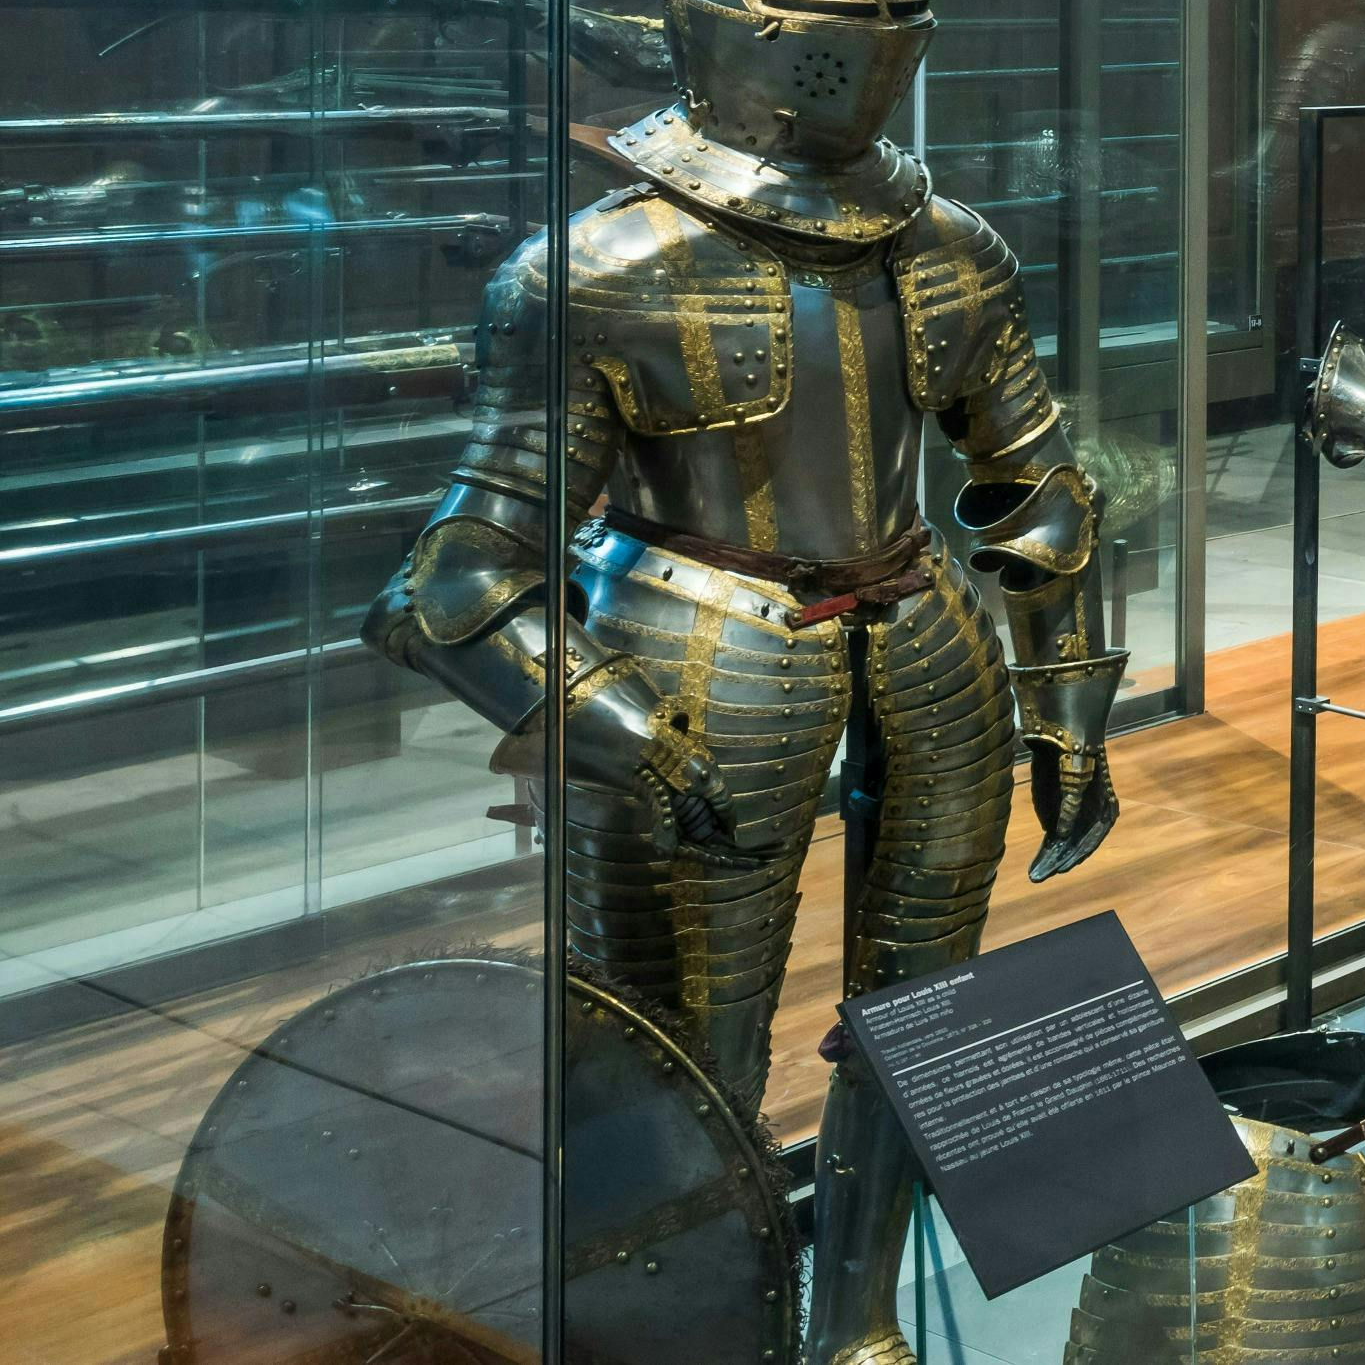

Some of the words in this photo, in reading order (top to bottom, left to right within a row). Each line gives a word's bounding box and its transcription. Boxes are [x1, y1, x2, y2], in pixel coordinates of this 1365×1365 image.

[862, 1002, 891, 1016] Armure
[892, 995, 910, 1007] pour
[911, 987, 933, 999] Louis
[933, 981, 948, 991] XIII
[949, 972, 974, 985] enfant
[897, 1080, 908, 1088] De
[912, 1064, 951, 1082] dimensions
[971, 1126, 980, 1135] de
[981, 1119, 1001, 1130] Louis
[1002, 1114, 1011, 1122] de
[1132, 1060, 1146, 1069] Des
[1000, 1136, 1019, 1148] Louis
